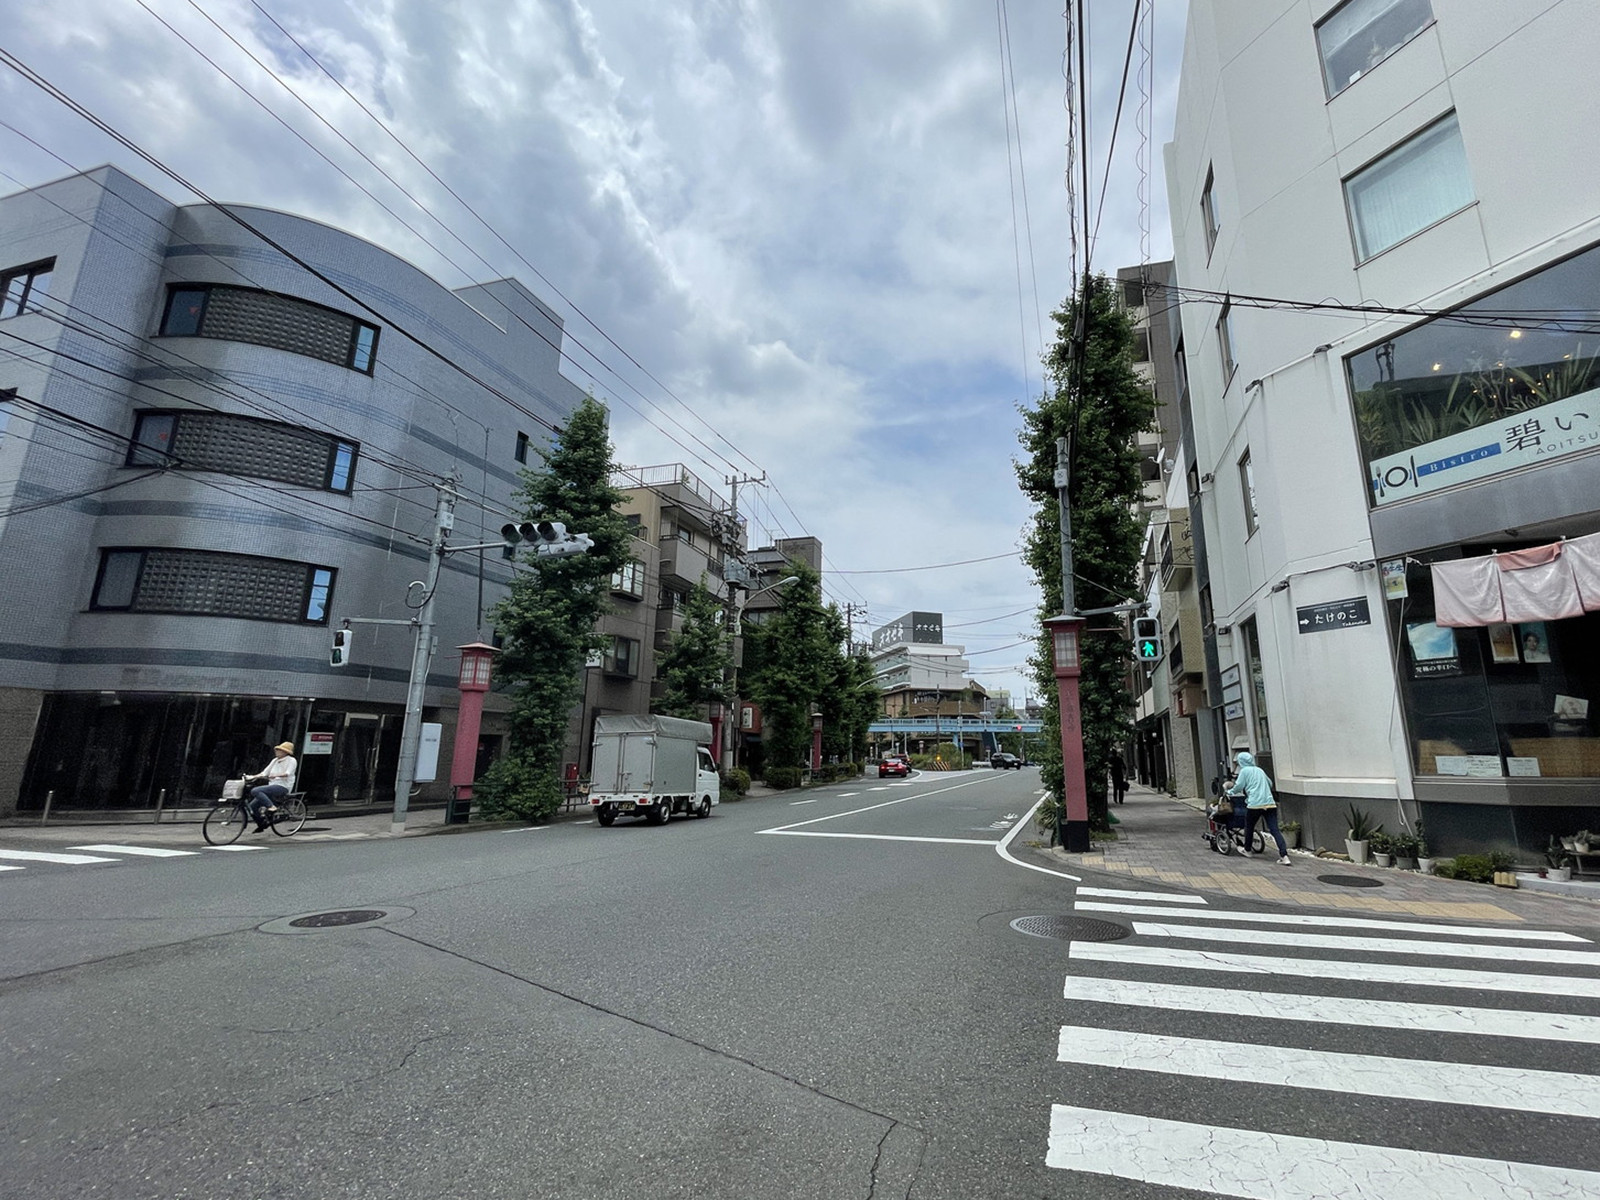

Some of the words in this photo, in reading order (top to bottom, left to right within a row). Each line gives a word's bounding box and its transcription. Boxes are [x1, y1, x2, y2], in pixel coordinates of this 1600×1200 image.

[1536, 431, 1598, 455] AOITSU
[1430, 449, 1489, 472] Bistro
[1315, 609, 1358, 625] たけのこ
